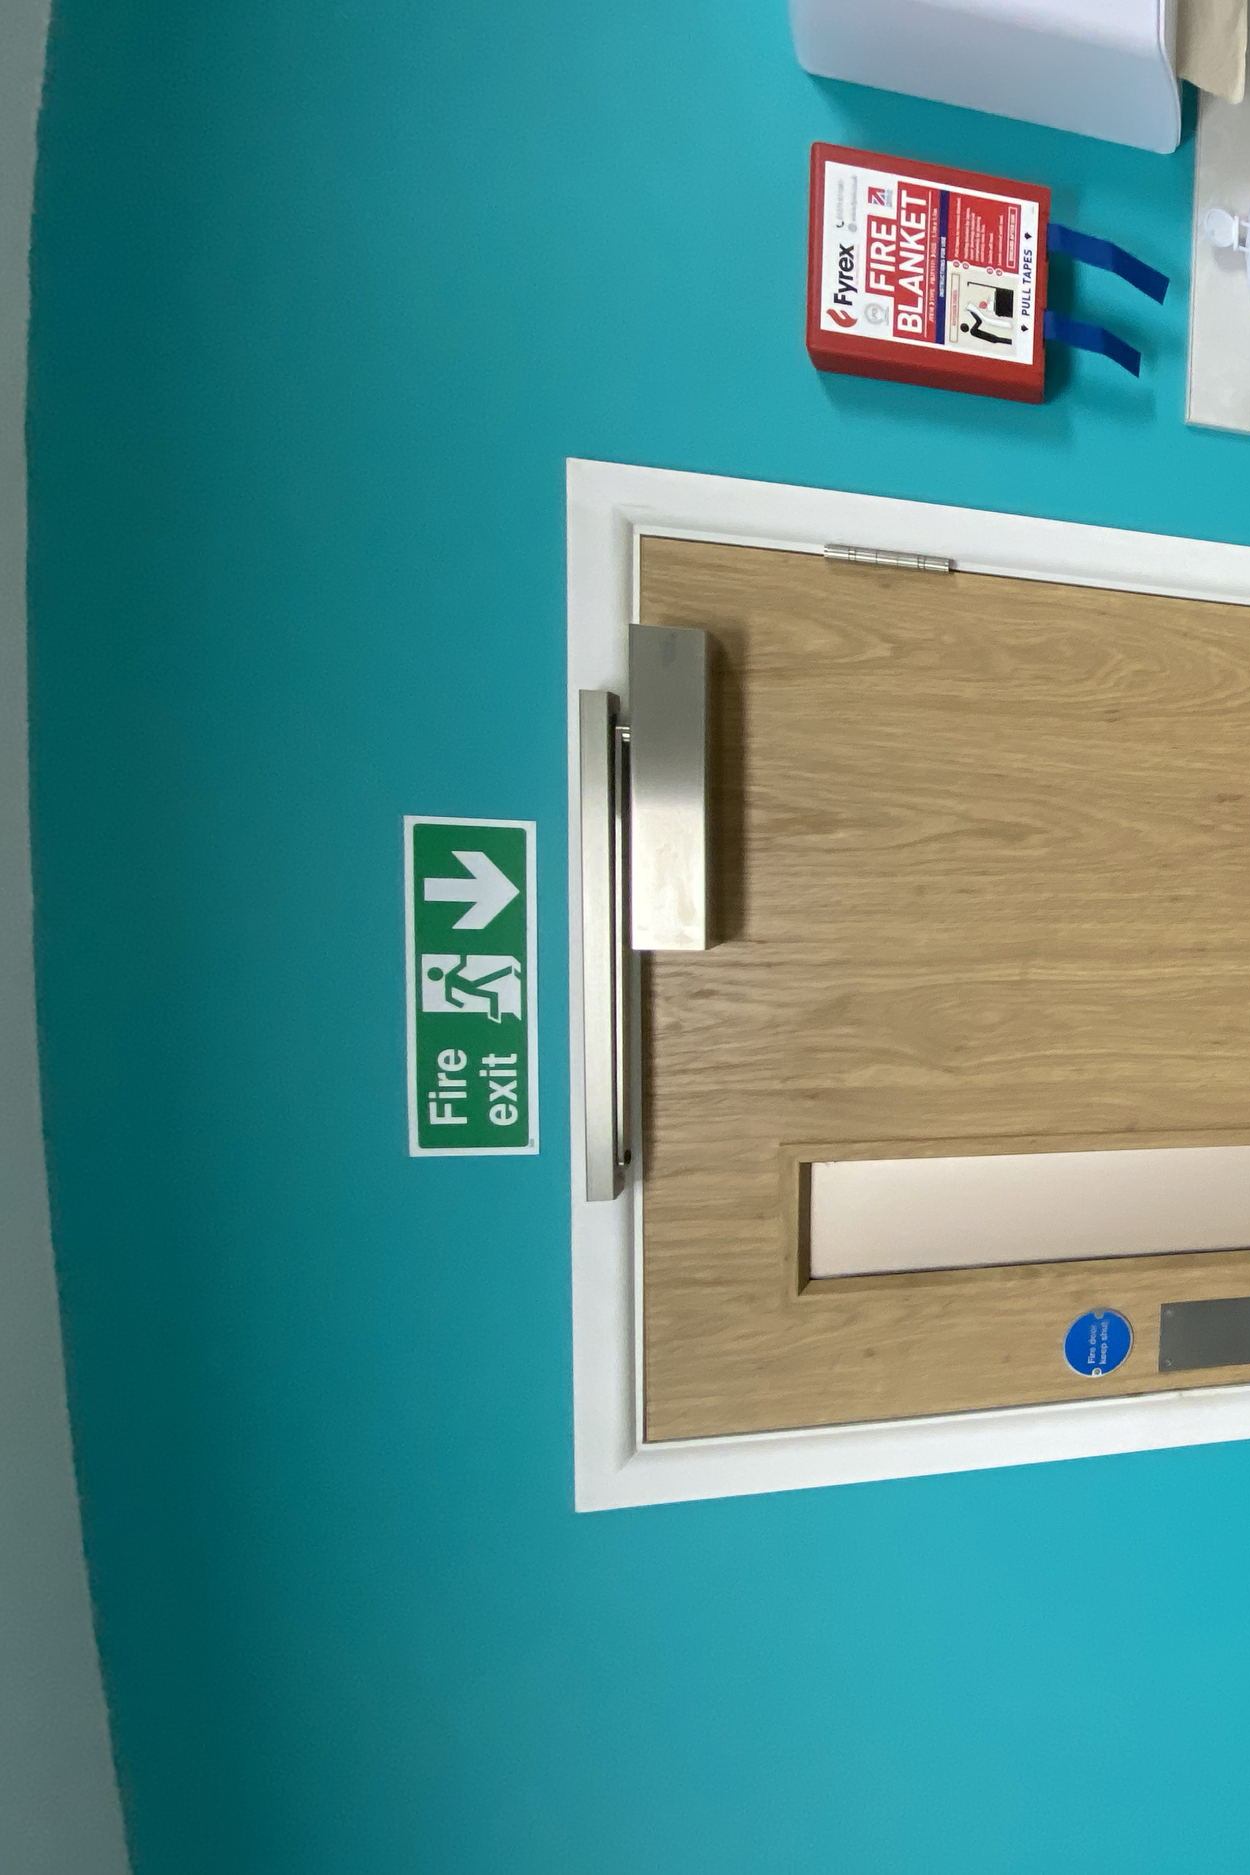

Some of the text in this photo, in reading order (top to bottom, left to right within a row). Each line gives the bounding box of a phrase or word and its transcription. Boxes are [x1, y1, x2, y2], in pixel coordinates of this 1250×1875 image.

[833, 243, 858, 306] Fyrex
[869, 221, 897, 292] FIRE
[897, 190, 928, 334] BLANKET
[1020, 249, 1033, 317] PULL TAPES
[428, 1048, 468, 1125] Fire
[479, 1053, 518, 1126] exit
[1088, 1325, 1097, 1364] Fire door
[1099, 1322, 1108, 1364] keep shut
